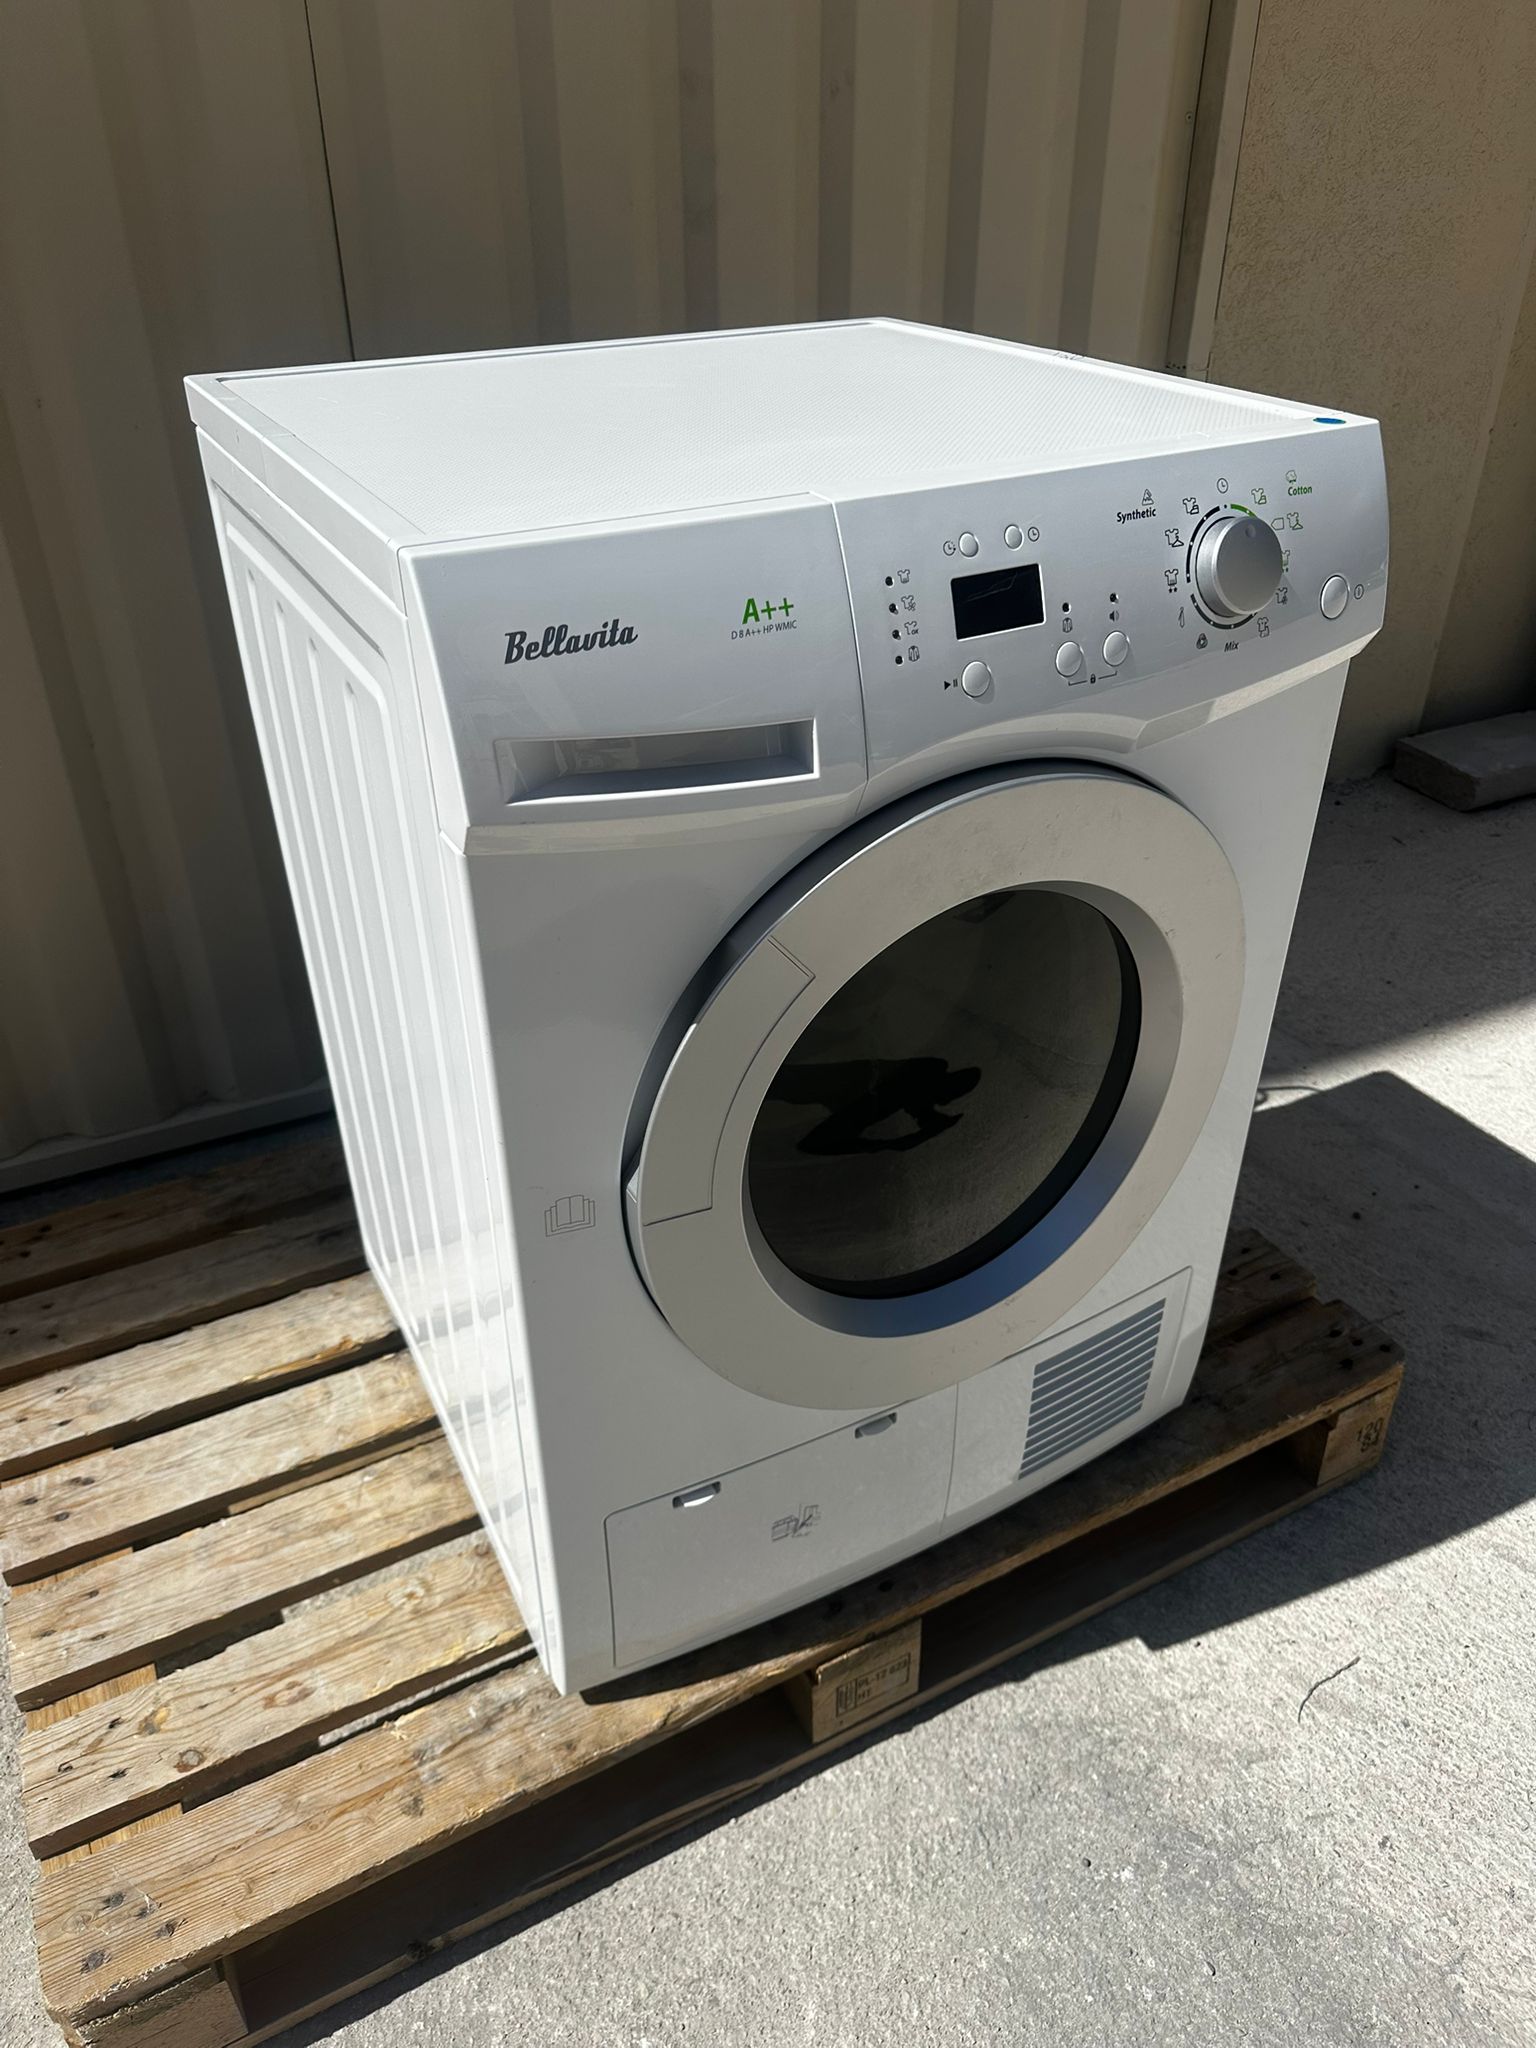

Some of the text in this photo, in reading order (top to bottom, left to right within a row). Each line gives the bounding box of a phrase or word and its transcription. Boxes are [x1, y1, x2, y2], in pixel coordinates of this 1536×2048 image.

[1287, 485, 1313, 496] Cotton
[1116, 507, 1157, 524] Synthetic
[742, 598, 794, 625] A++
[731, 620, 797, 640] D 8 A++ HP WMIC
[504, 618, 639, 665] Bellavita
[1224, 641, 1240, 653] Mix
